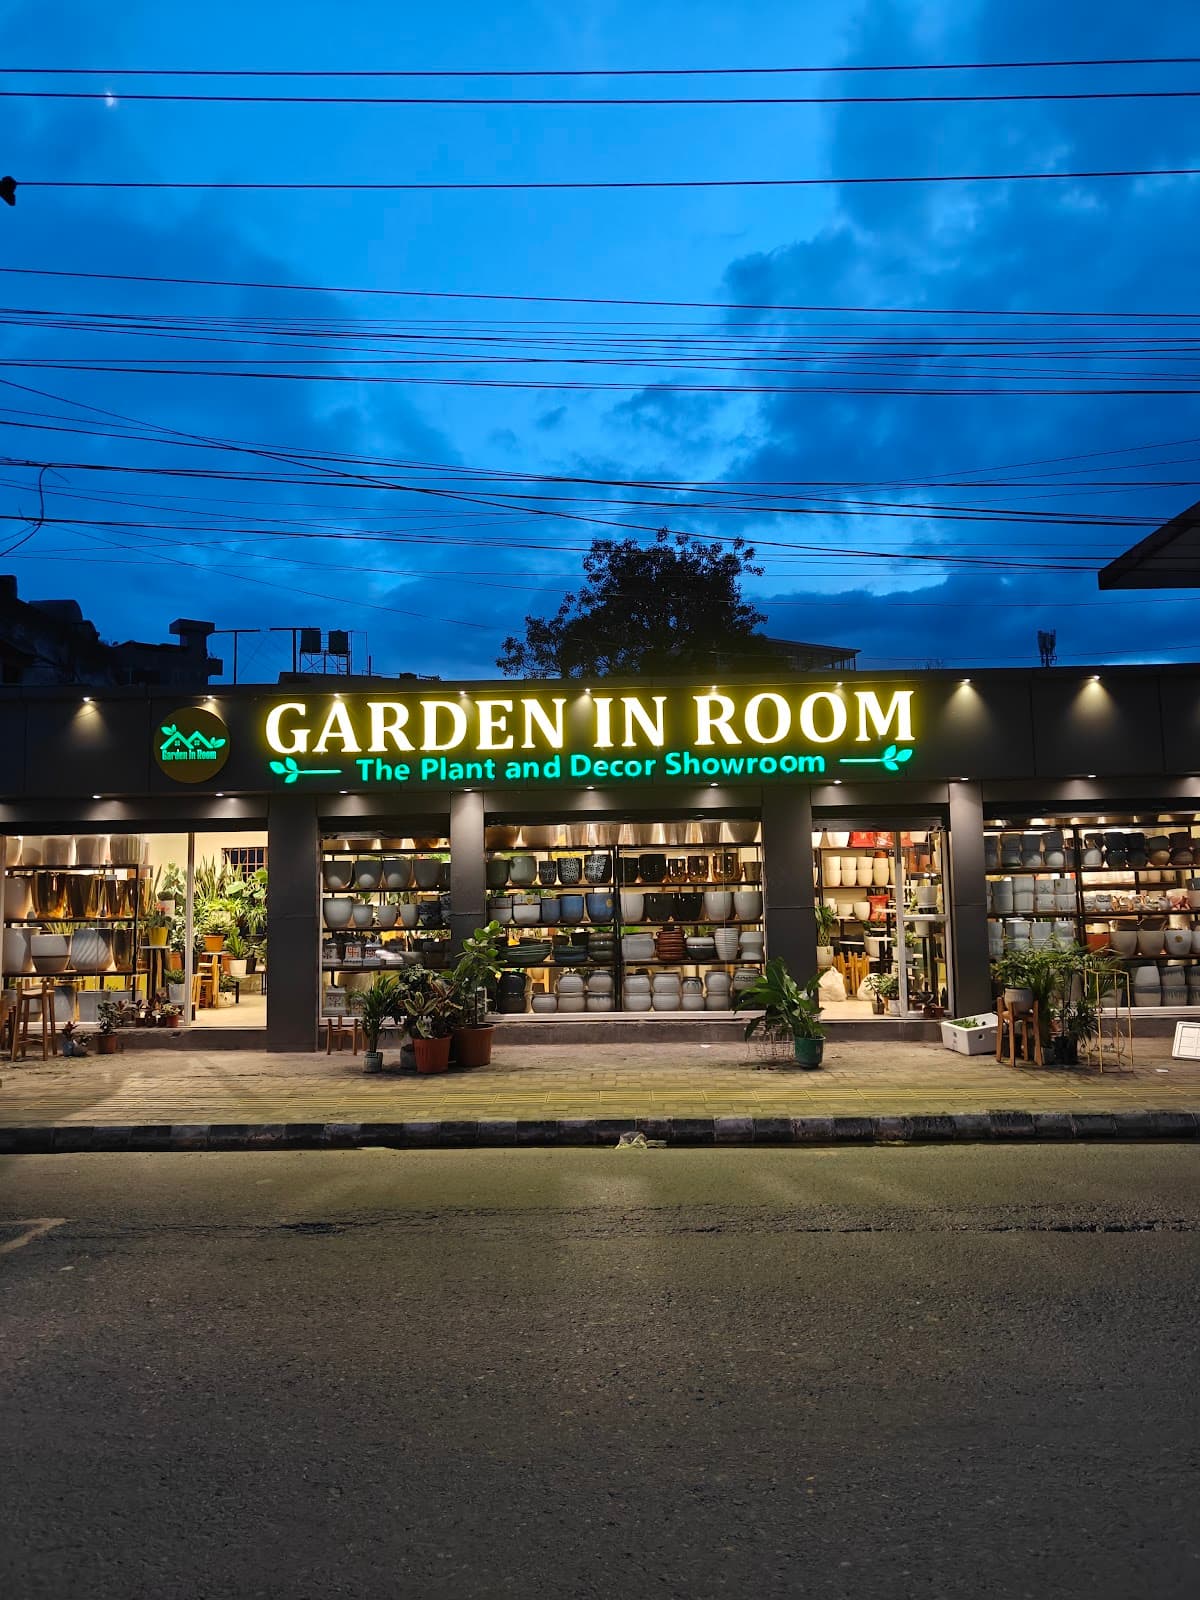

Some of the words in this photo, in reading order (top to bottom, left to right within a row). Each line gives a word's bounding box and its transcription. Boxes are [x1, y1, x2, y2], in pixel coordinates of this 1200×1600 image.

[265, 698, 567, 754] GARDEN
[593, 696, 667, 748] IN
[693, 690, 915, 745] ROOM
[162, 749, 187, 760] Garden
[197, 749, 217, 760] Room
[356, 758, 410, 782] The
[421, 758, 495, 781] Plant
[506, 755, 561, 780] and
[571, 753, 656, 778] Decor
[665, 751, 825, 776] Showroom
